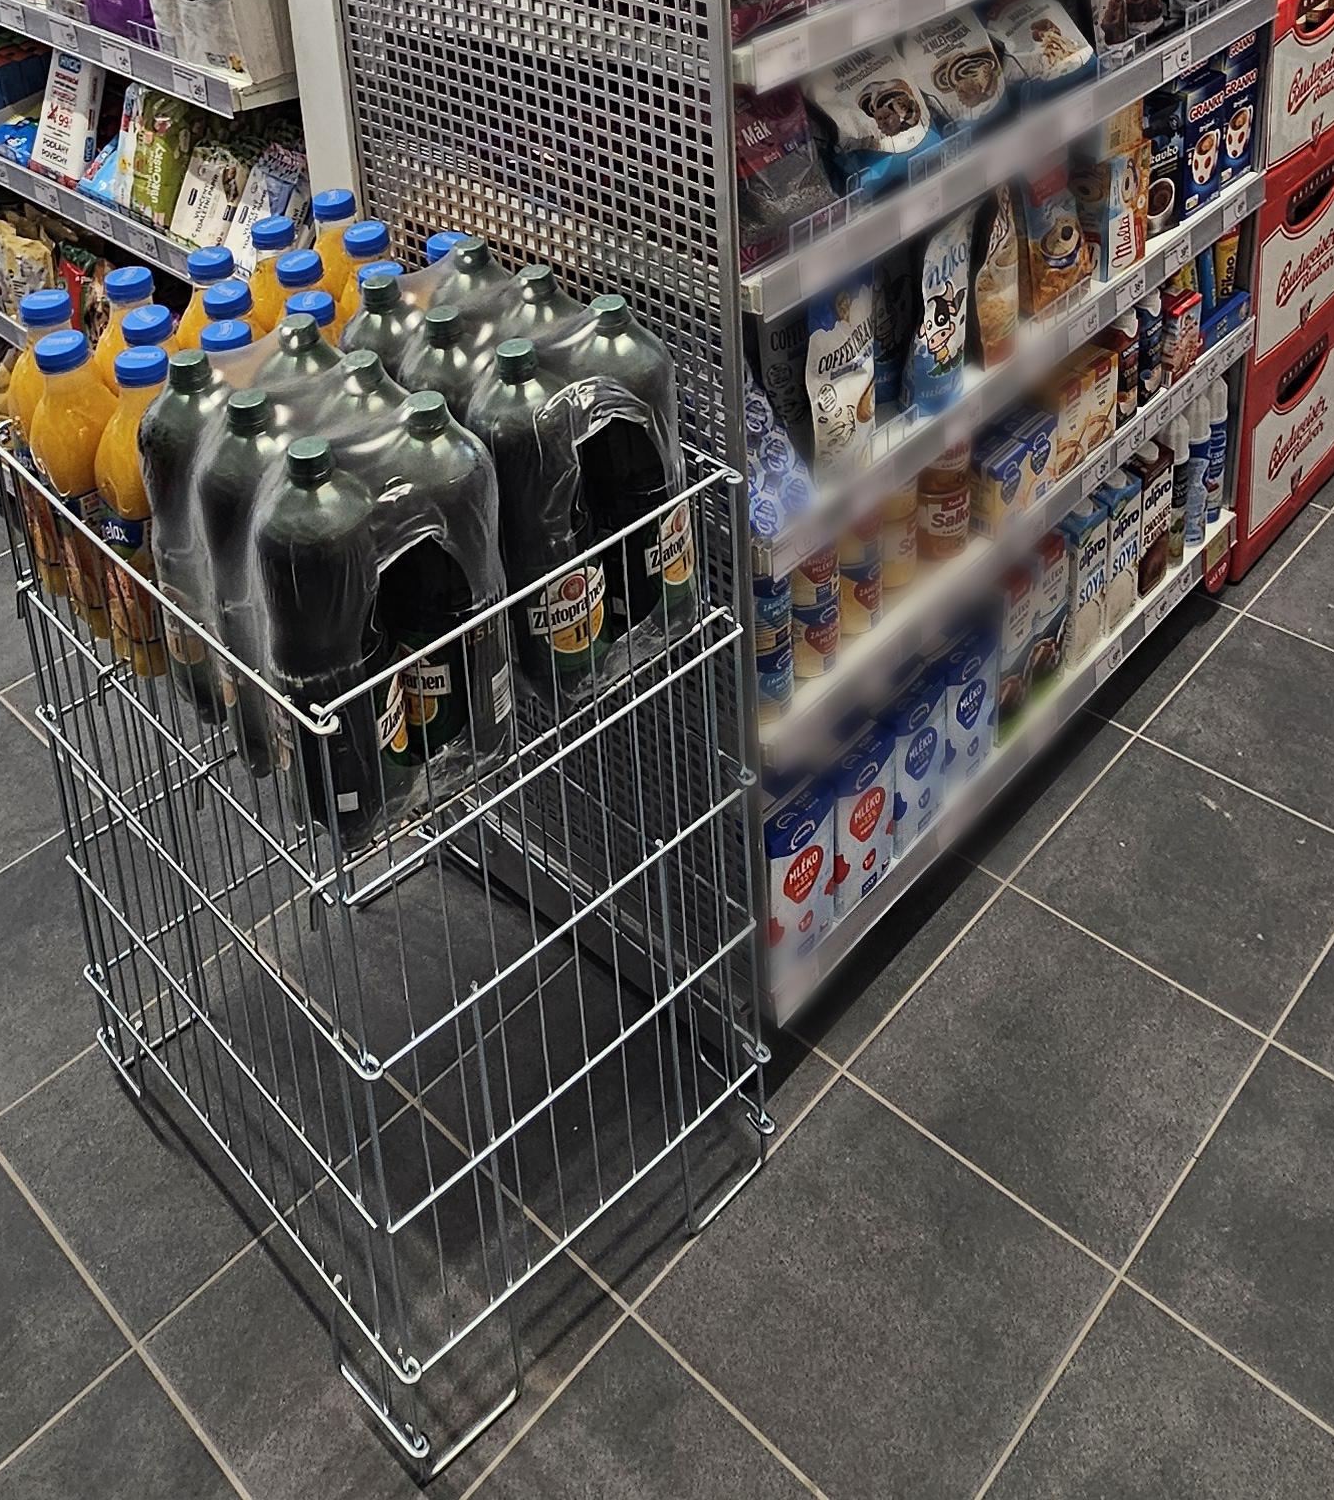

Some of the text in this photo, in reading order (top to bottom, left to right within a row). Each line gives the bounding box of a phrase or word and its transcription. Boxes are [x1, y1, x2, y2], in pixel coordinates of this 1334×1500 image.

[1224, 68, 1259, 97] GRANKO
[1189, 91, 1225, 122] GRANKO
[740, 120, 773, 148] Mák
[152, 143, 166, 204] UBROUSKY
[1220, 255, 1236, 299] Pikao
[1267, 395, 1329, 482] Budweiser
[1144, 479, 1172, 511] alpro
[1113, 508, 1140, 542] alpro
[1079, 535, 1107, 571] alpro
[1113, 539, 1139, 577] SOYA
[1079, 569, 1105, 606] SOYA
[960, 684, 983, 712] MLÉKO
[909, 731, 934, 761] MLÉKO
[854, 791, 882, 823] MLÉKO
[789, 850, 819, 884] MLÉKO
